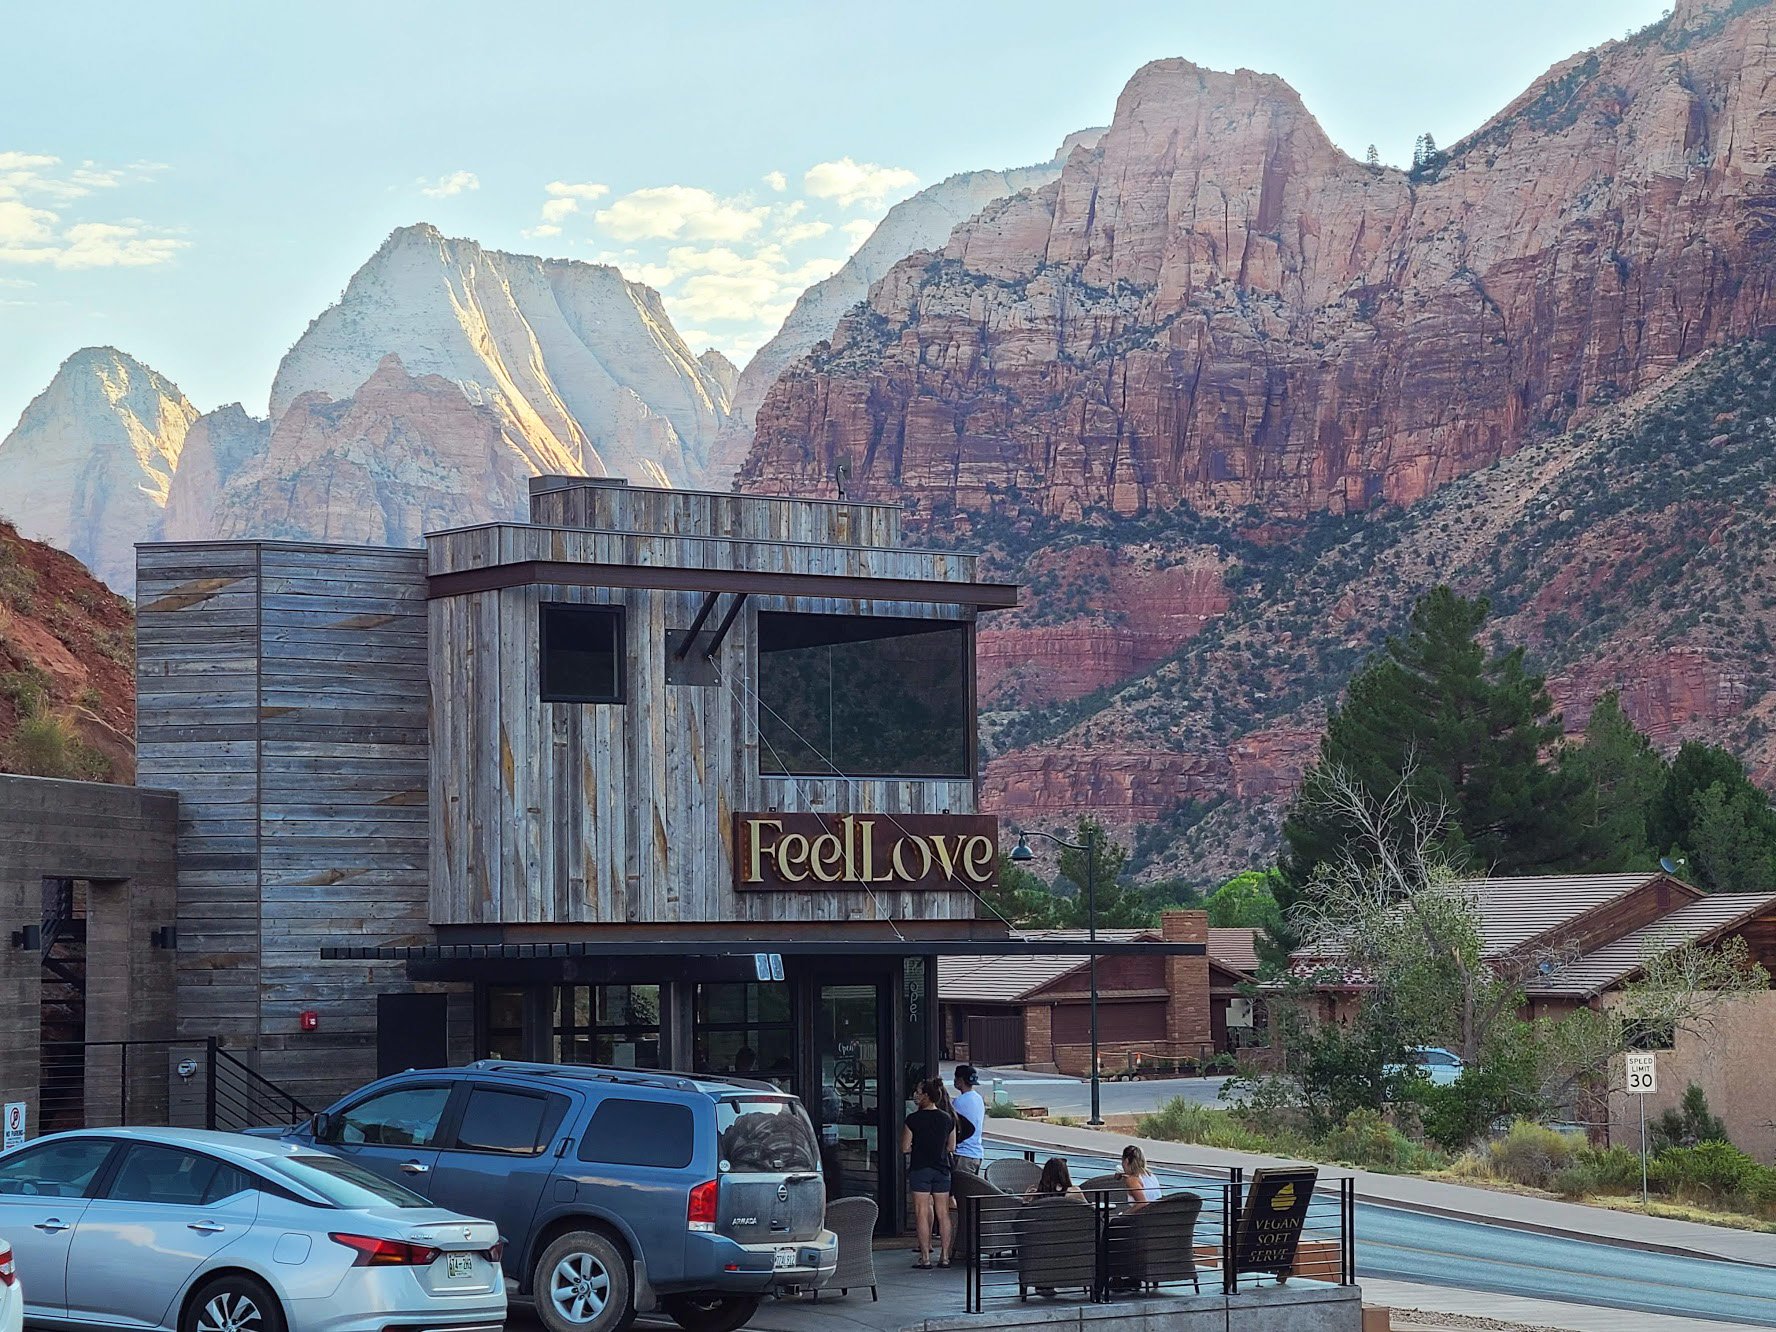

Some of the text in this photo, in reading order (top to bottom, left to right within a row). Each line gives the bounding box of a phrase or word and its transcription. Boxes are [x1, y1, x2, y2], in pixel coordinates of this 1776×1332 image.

[1630, 1074, 1652, 1087] 30
[1256, 1218, 1299, 1230] VEGAN
[1257, 1232, 1291, 1246] SOFT
[1248, 1248, 1288, 1263] SERVE
